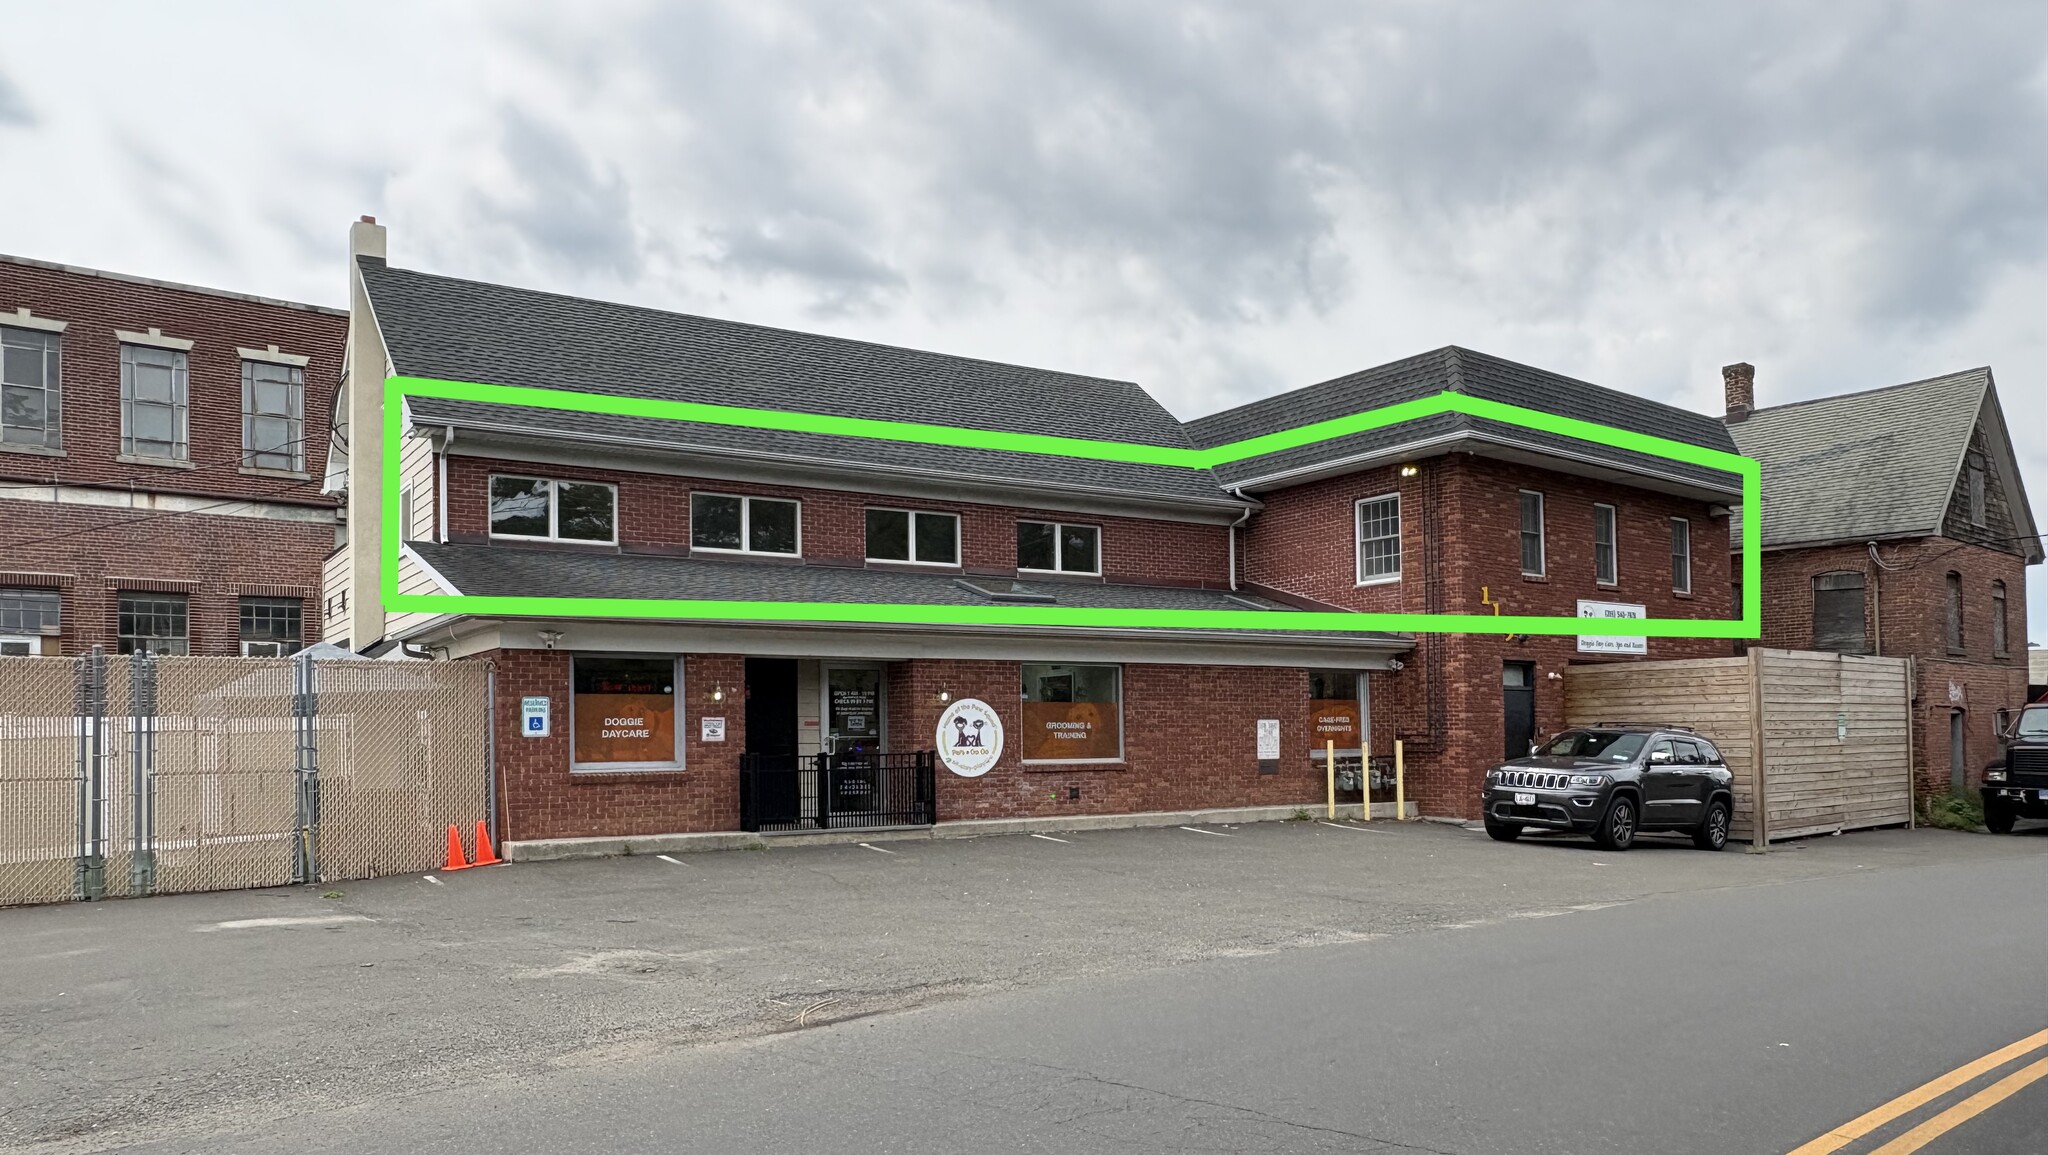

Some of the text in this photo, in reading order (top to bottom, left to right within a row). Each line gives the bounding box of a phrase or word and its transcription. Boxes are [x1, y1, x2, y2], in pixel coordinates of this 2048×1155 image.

[604, 717, 644, 726] DOGGIE
[1045, 721, 1086, 730] GROOMING
[601, 729, 650, 738] DAYCARE
[1053, 731, 1087, 739] TRAINING
